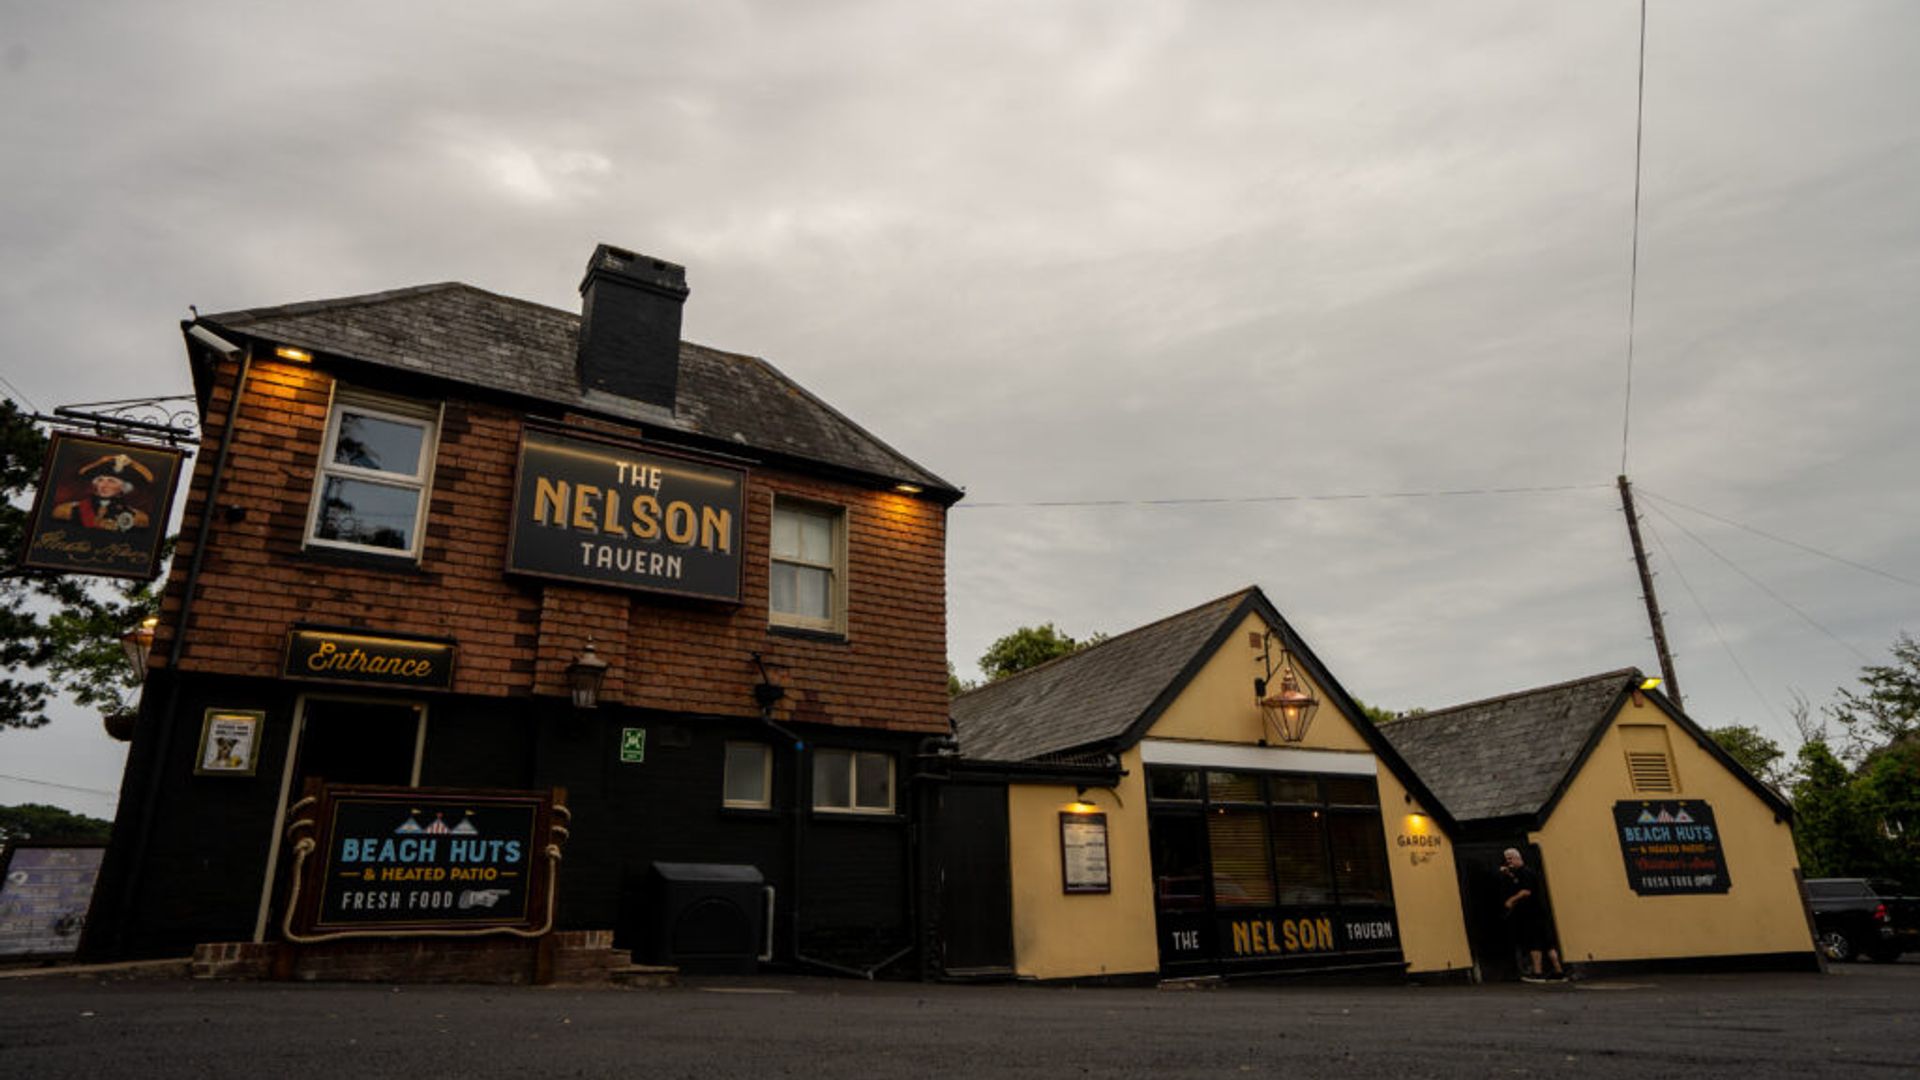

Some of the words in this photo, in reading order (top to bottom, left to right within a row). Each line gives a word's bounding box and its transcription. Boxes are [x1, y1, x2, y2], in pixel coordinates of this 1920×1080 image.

[616, 460, 662, 491] THE
[532, 476, 732, 555] NELSON
[581, 542, 682, 579] TAVERN
[307, 640, 433, 677] Entrance
[1397, 834, 1441, 847] GARDEN
[1624, 826, 1671, 841] BEACH
[1675, 825, 1713, 841] HUTS
[341, 838, 437, 863] BEACH
[450, 840, 521, 863] HUTS
[363, 868, 376, 881] &
[381, 867, 446, 881] HEATED
[450, 867, 498, 881] PATIO
[342, 891, 400, 909] FRESH
[408, 890, 453, 909] FOOD
[1172, 930, 1200, 950] THE
[1231, 918, 1335, 955] NELSON
[1346, 921, 1393, 941] TAVERN
